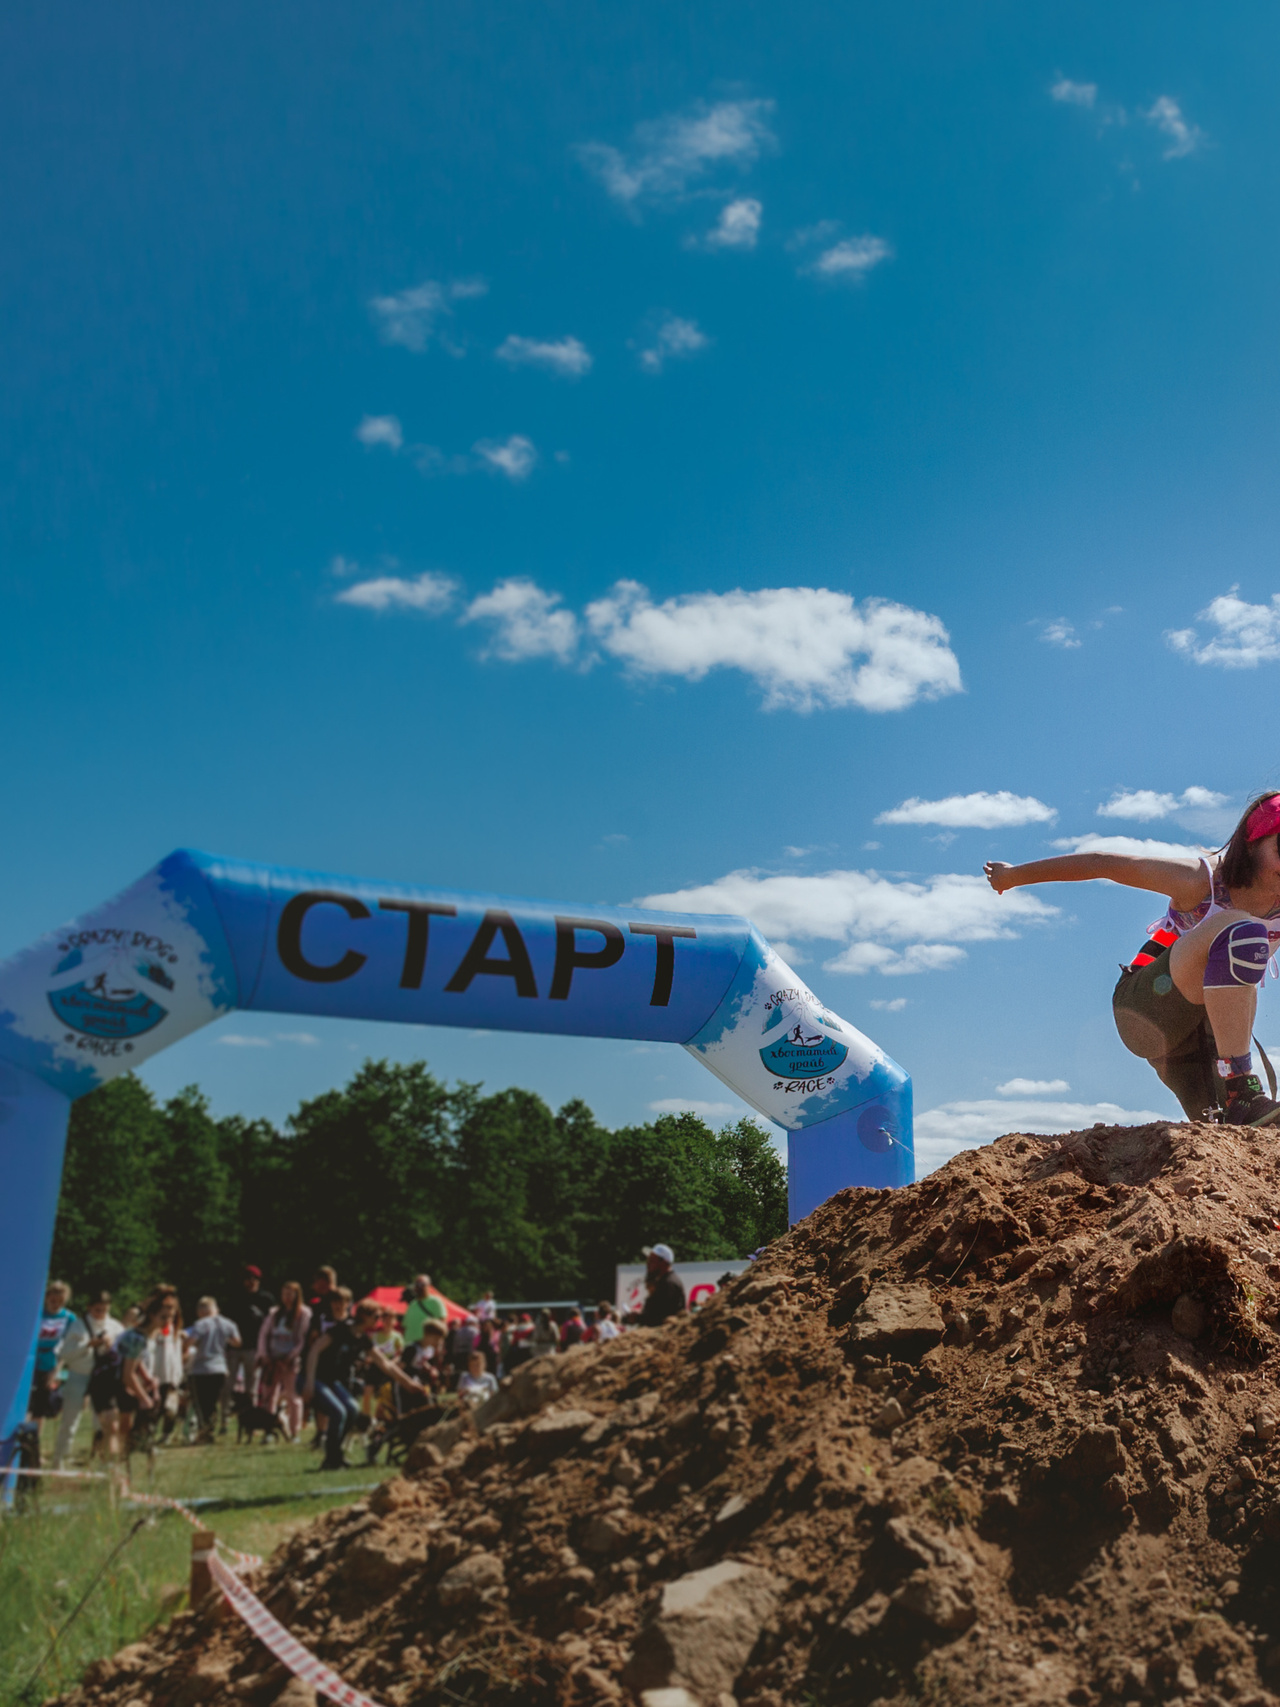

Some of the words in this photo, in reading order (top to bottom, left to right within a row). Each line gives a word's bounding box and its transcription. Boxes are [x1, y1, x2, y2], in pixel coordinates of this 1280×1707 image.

[67, 929, 123, 948] CRAZY
[130, 931, 175, 958] DOG
[277, 889, 697, 1007] СТАРТ
[769, 988, 800, 1006] CRAZY
[75, 1036, 123, 1058] RACE
[770, 1046, 839, 1059] хвостатый
[784, 1078, 827, 1095] RACE
